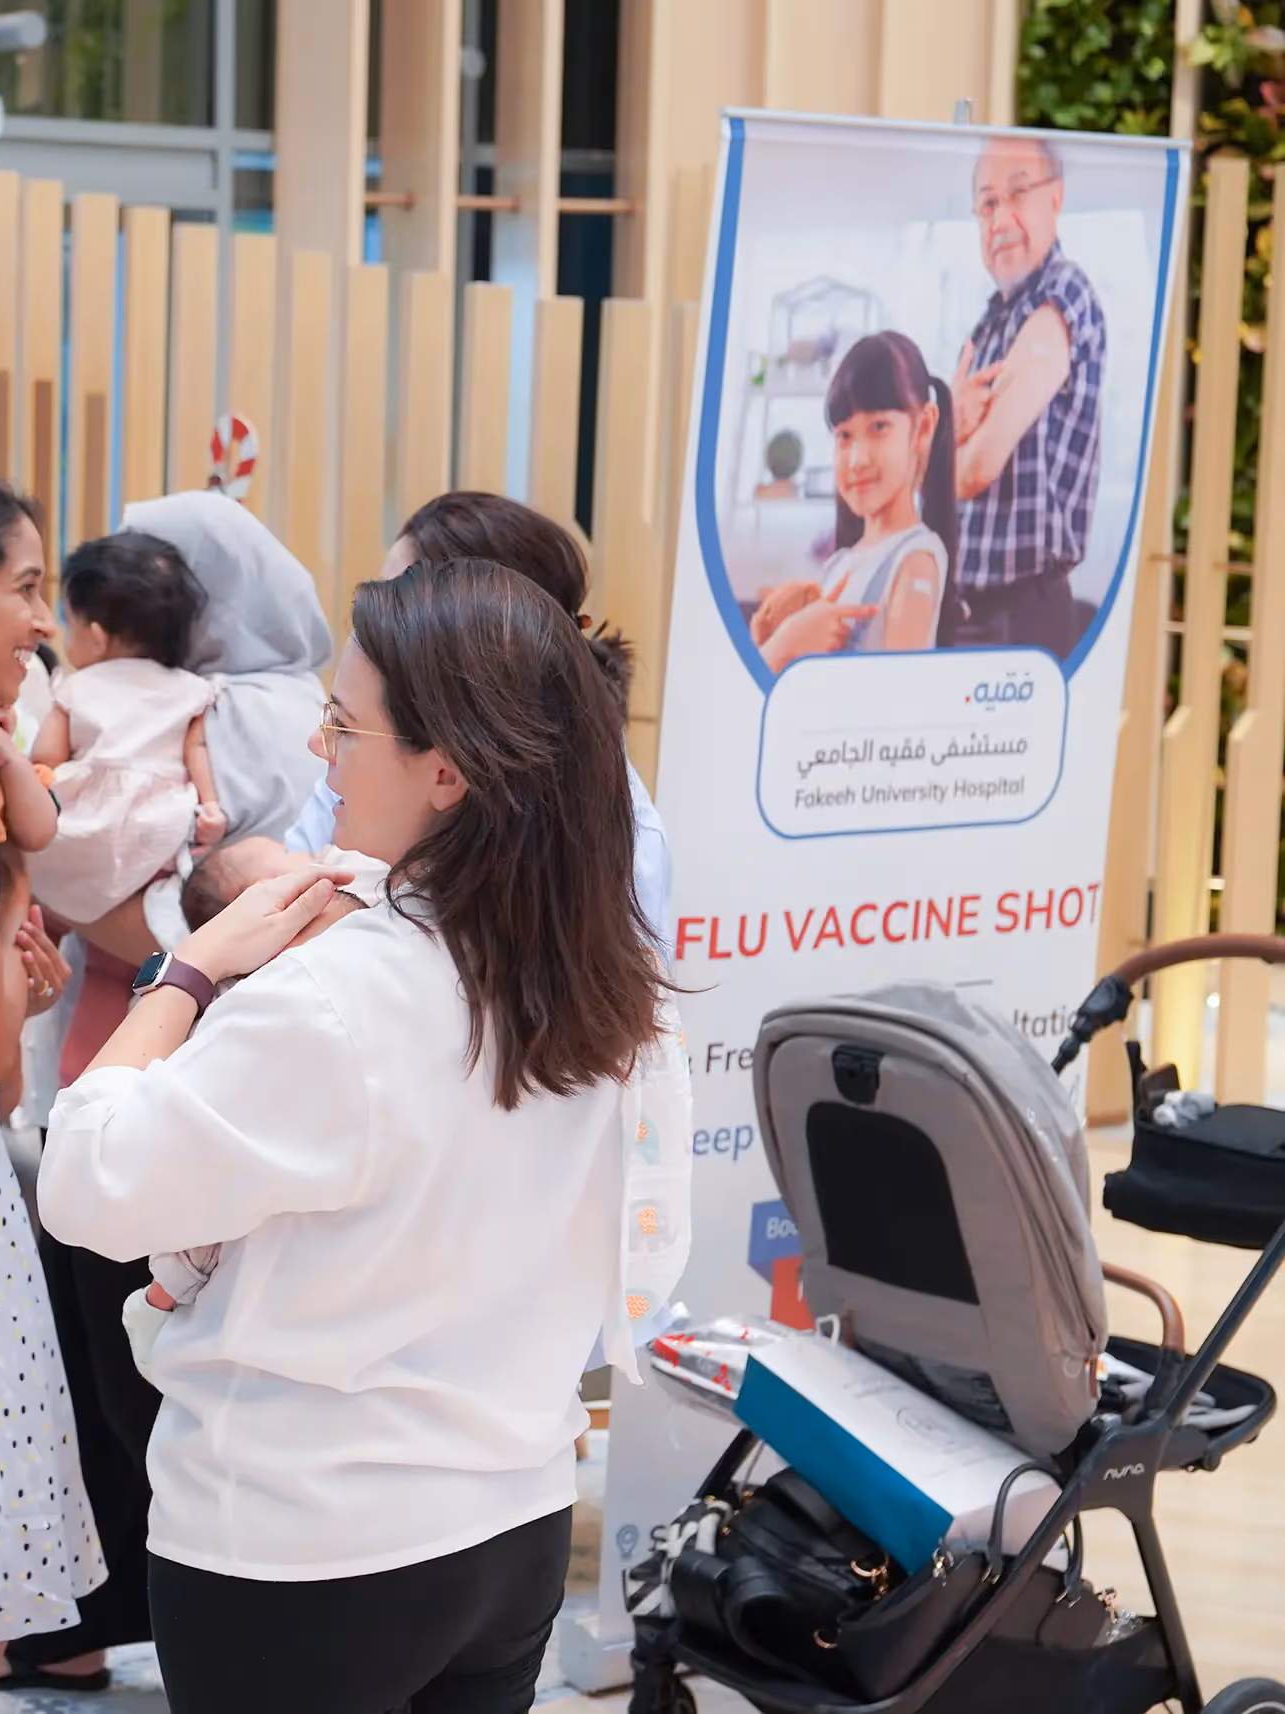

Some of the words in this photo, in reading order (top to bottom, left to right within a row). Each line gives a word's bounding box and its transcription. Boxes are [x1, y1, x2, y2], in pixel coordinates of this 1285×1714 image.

[797, 739, 874, 779] الجامعي
[879, 737, 926, 767] فقيه
[794, 786, 855, 809] Fakeeh
[861, 780, 949, 805] University
[953, 776, 1025, 800] Hospital
[675, 913, 769, 961] FLU
[784, 895, 981, 952] VACCINE
[994, 882, 1101, 933] SHOT
[705, 1041, 755, 1074] Fre
[692, 1124, 754, 1163] eep
